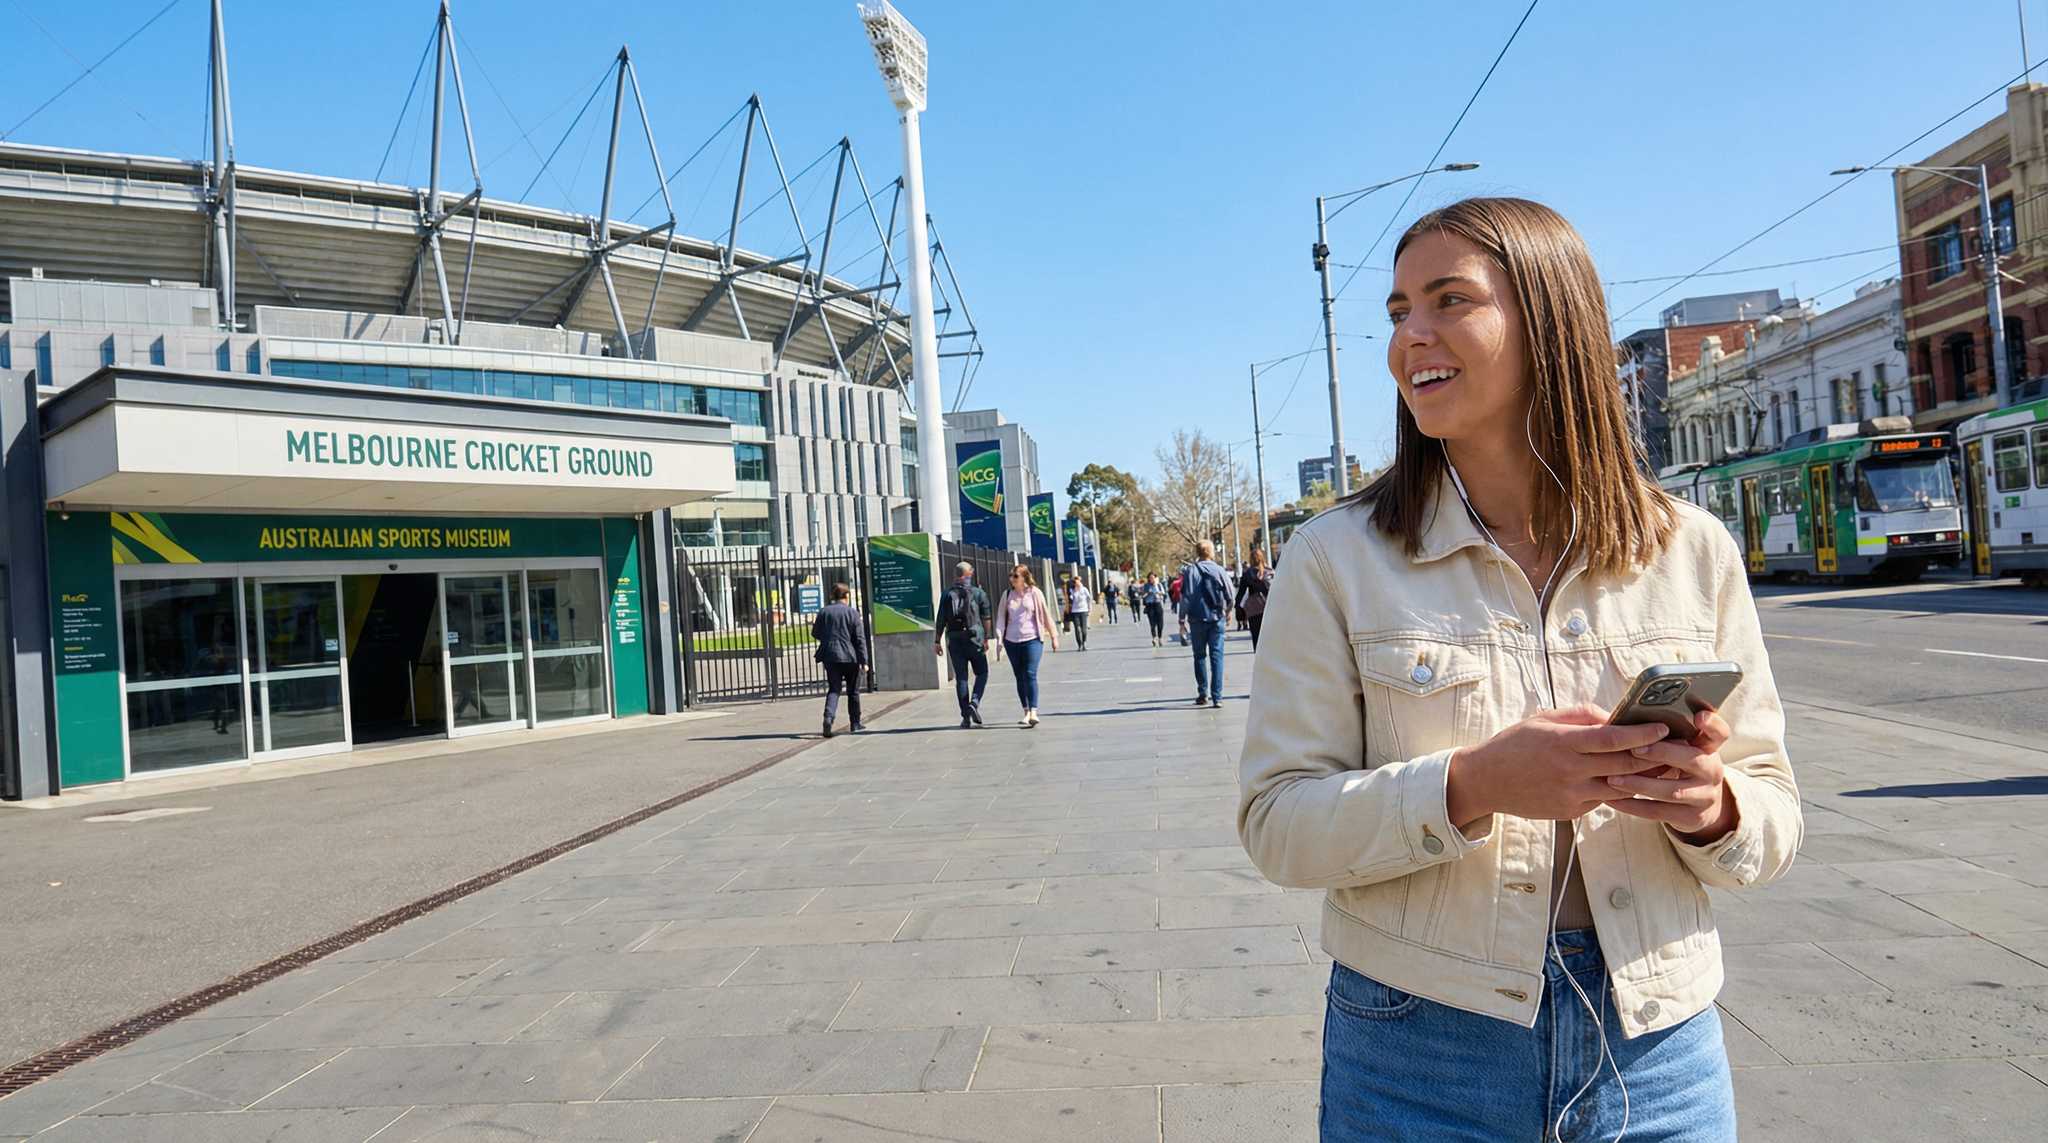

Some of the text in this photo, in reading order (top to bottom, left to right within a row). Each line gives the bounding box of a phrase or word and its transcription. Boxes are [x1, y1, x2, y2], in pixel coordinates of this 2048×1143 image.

[286, 430, 653, 477] MELBOURNE CRICKET GROUND
[960, 468, 995, 485] MCG
[260, 528, 511, 548] AUSTRALIAN SPORTS MUSEUM
